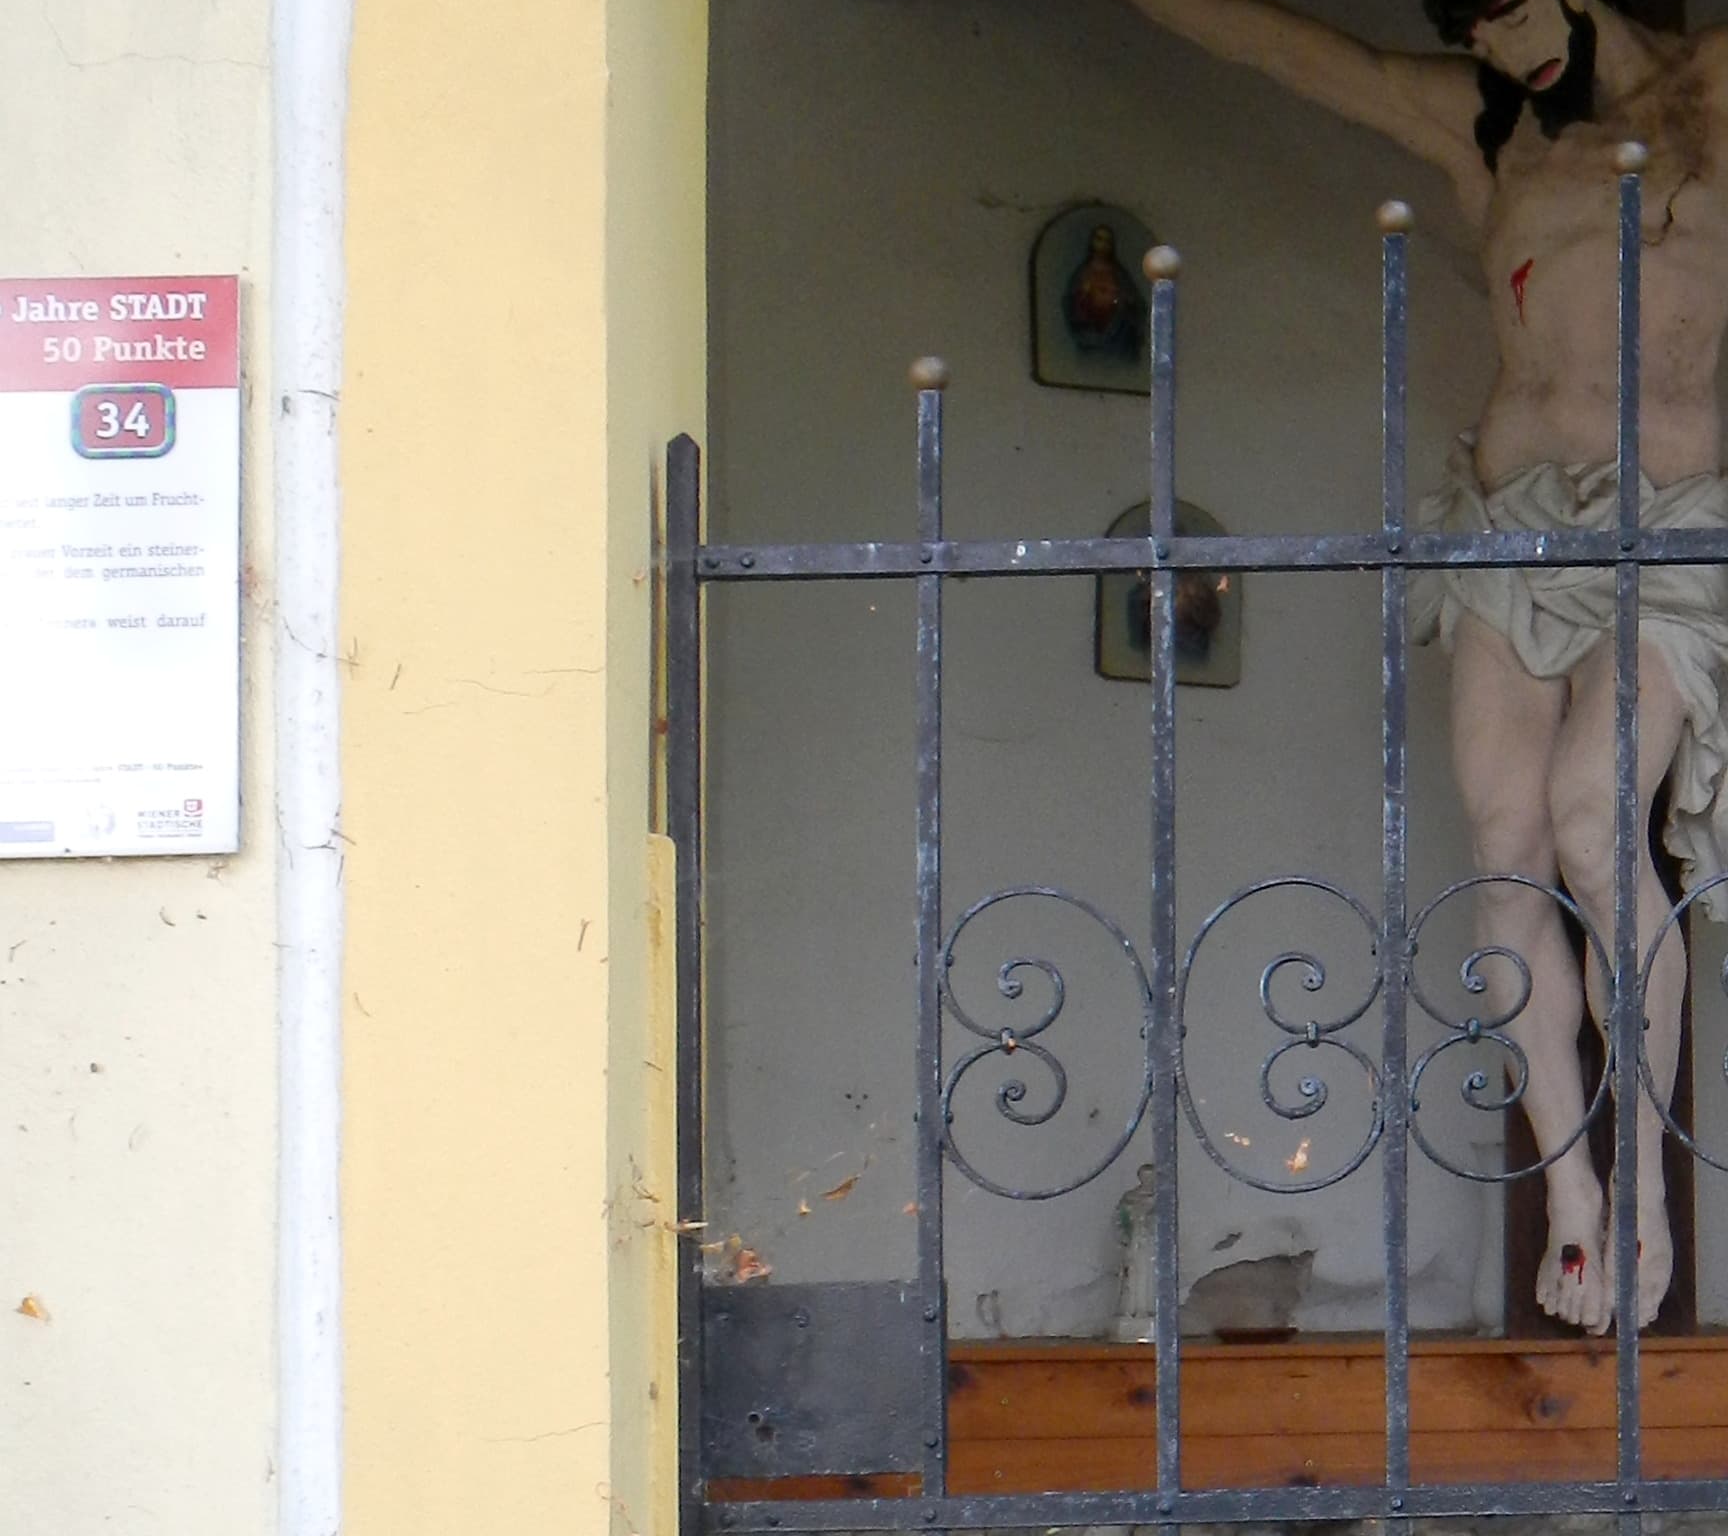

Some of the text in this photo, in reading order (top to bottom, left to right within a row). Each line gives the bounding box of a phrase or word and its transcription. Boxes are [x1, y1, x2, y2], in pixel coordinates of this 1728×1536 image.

[12, 294, 99, 322] Jahre
[109, 293, 207, 320] STADT
[43, 334, 206, 363] 50 Punkte
[95, 401, 150, 438] 34
[92, 493, 121, 508] Zeit
[125, 496, 148, 508] um
[152, 491, 205, 507] Frucht-
[61, 544, 114, 559] Vorzeit
[119, 544, 143, 558] ein
[102, 563, 205, 582] germanischen
[107, 613, 147, 629] weist
[156, 611, 206, 629] darauf
